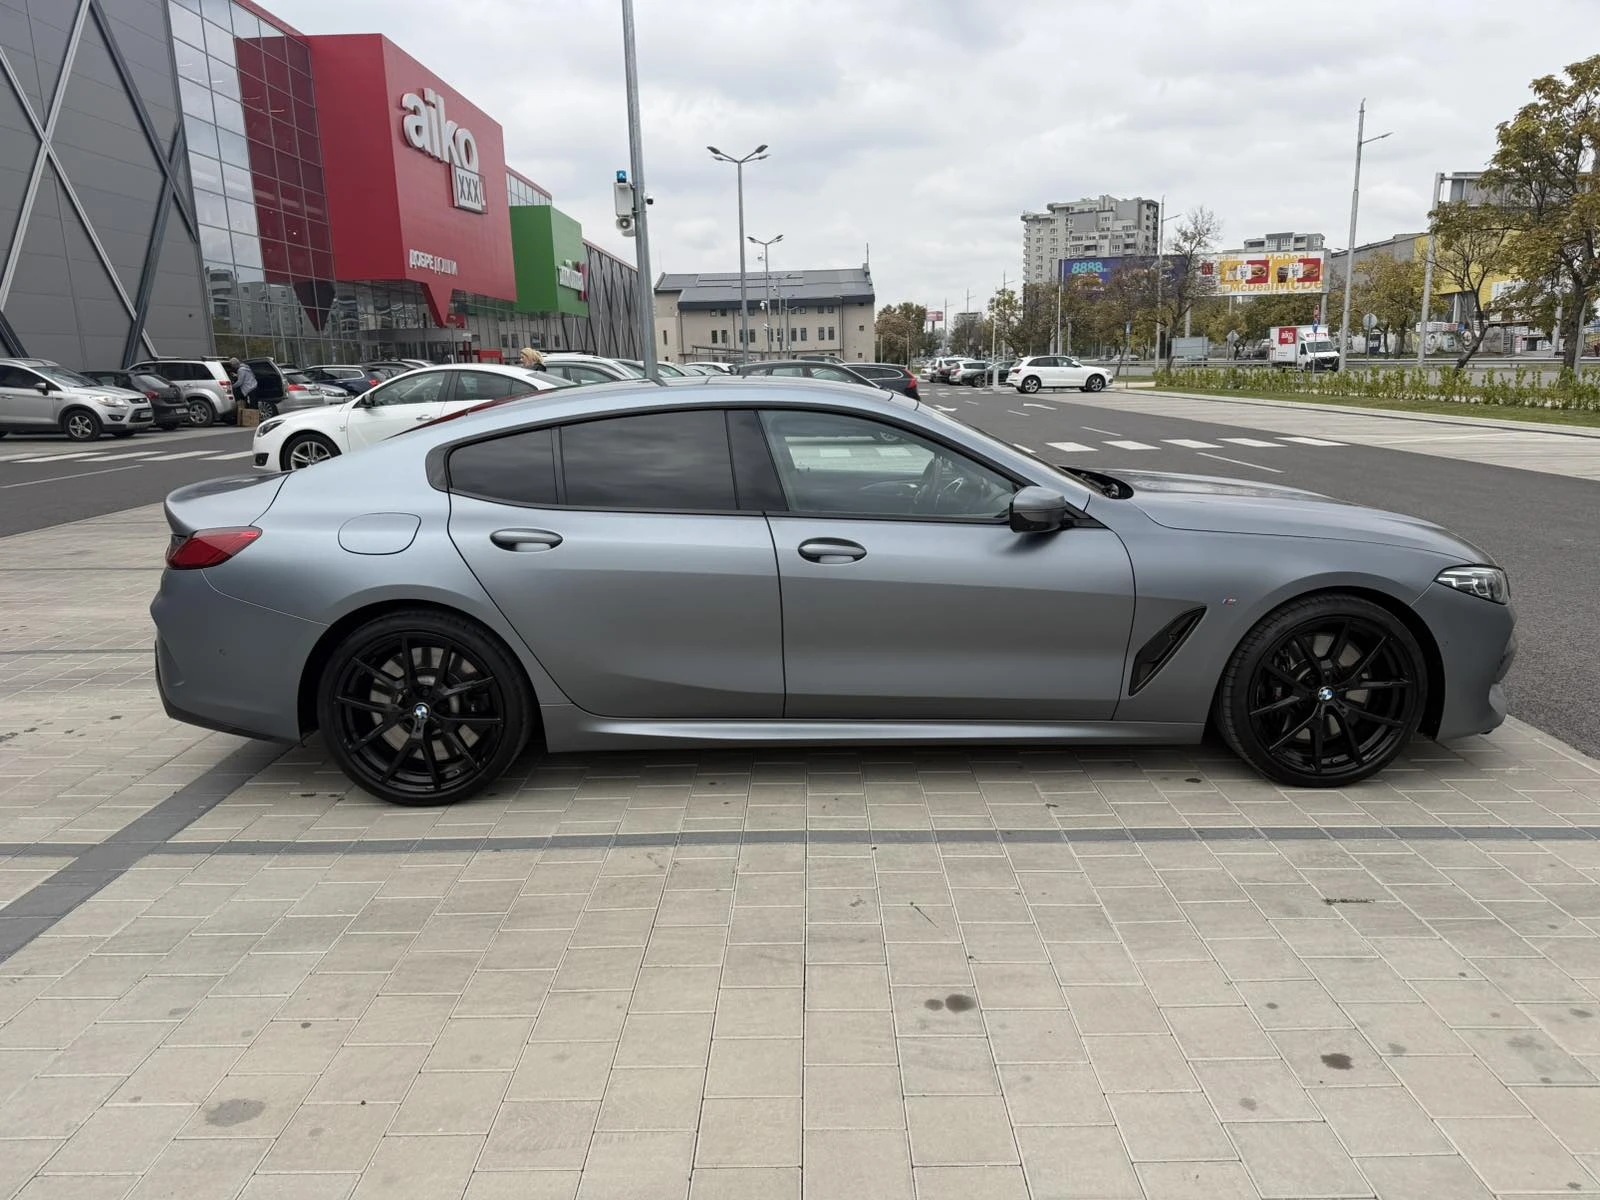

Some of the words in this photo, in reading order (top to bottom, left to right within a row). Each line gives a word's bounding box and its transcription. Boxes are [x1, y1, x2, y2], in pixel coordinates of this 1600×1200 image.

[401, 87, 479, 174] aiko
[409, 248, 434, 270] ДОБРЕ
[434, 256, 458, 276] ДОШЛИ
